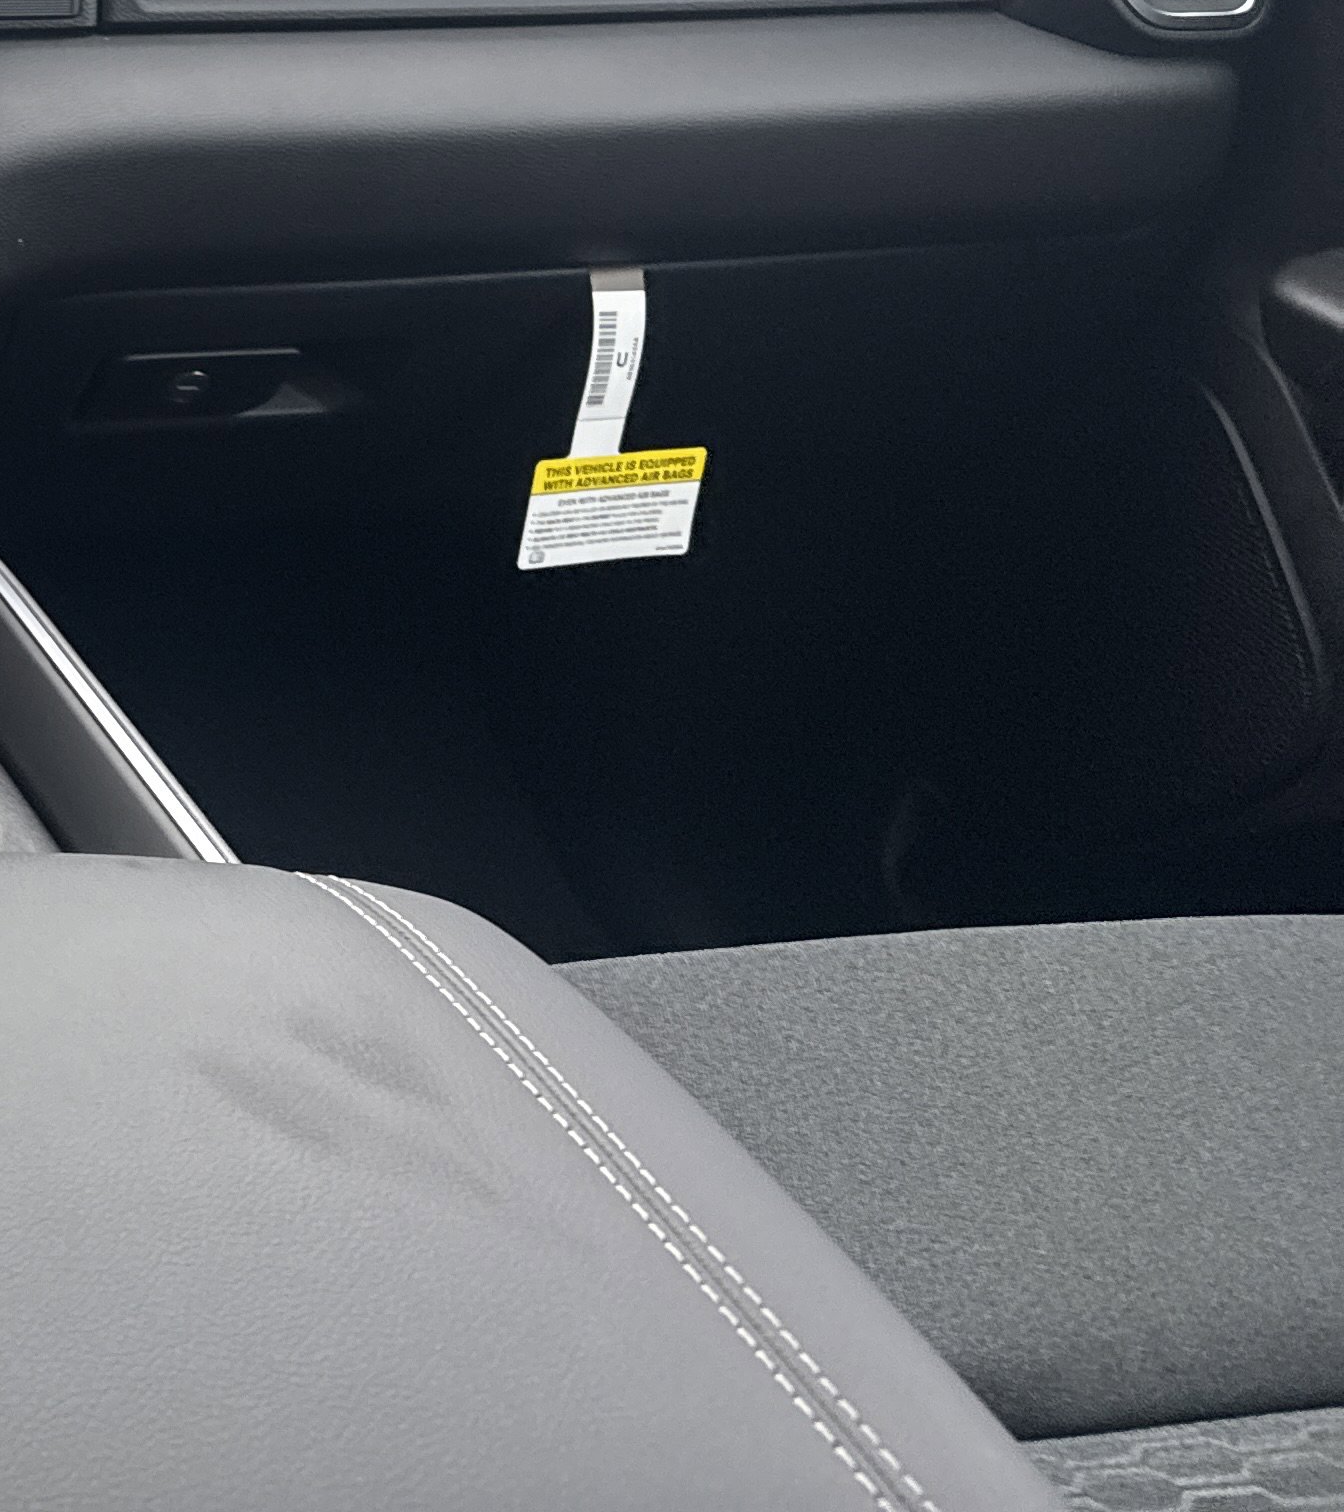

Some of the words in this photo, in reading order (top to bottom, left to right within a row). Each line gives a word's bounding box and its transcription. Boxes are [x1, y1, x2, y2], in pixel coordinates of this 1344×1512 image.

[545, 465, 572, 479] THIS
[574, 461, 624, 476] VEHICLE
[625, 459, 638, 471] IS
[639, 455, 697, 471] EQUIPPED
[543, 478, 573, 492] WITH
[575, 472, 639, 488] ADVANCED
[641, 470, 661, 482] AIR
[662, 467, 695, 480] BAGS
